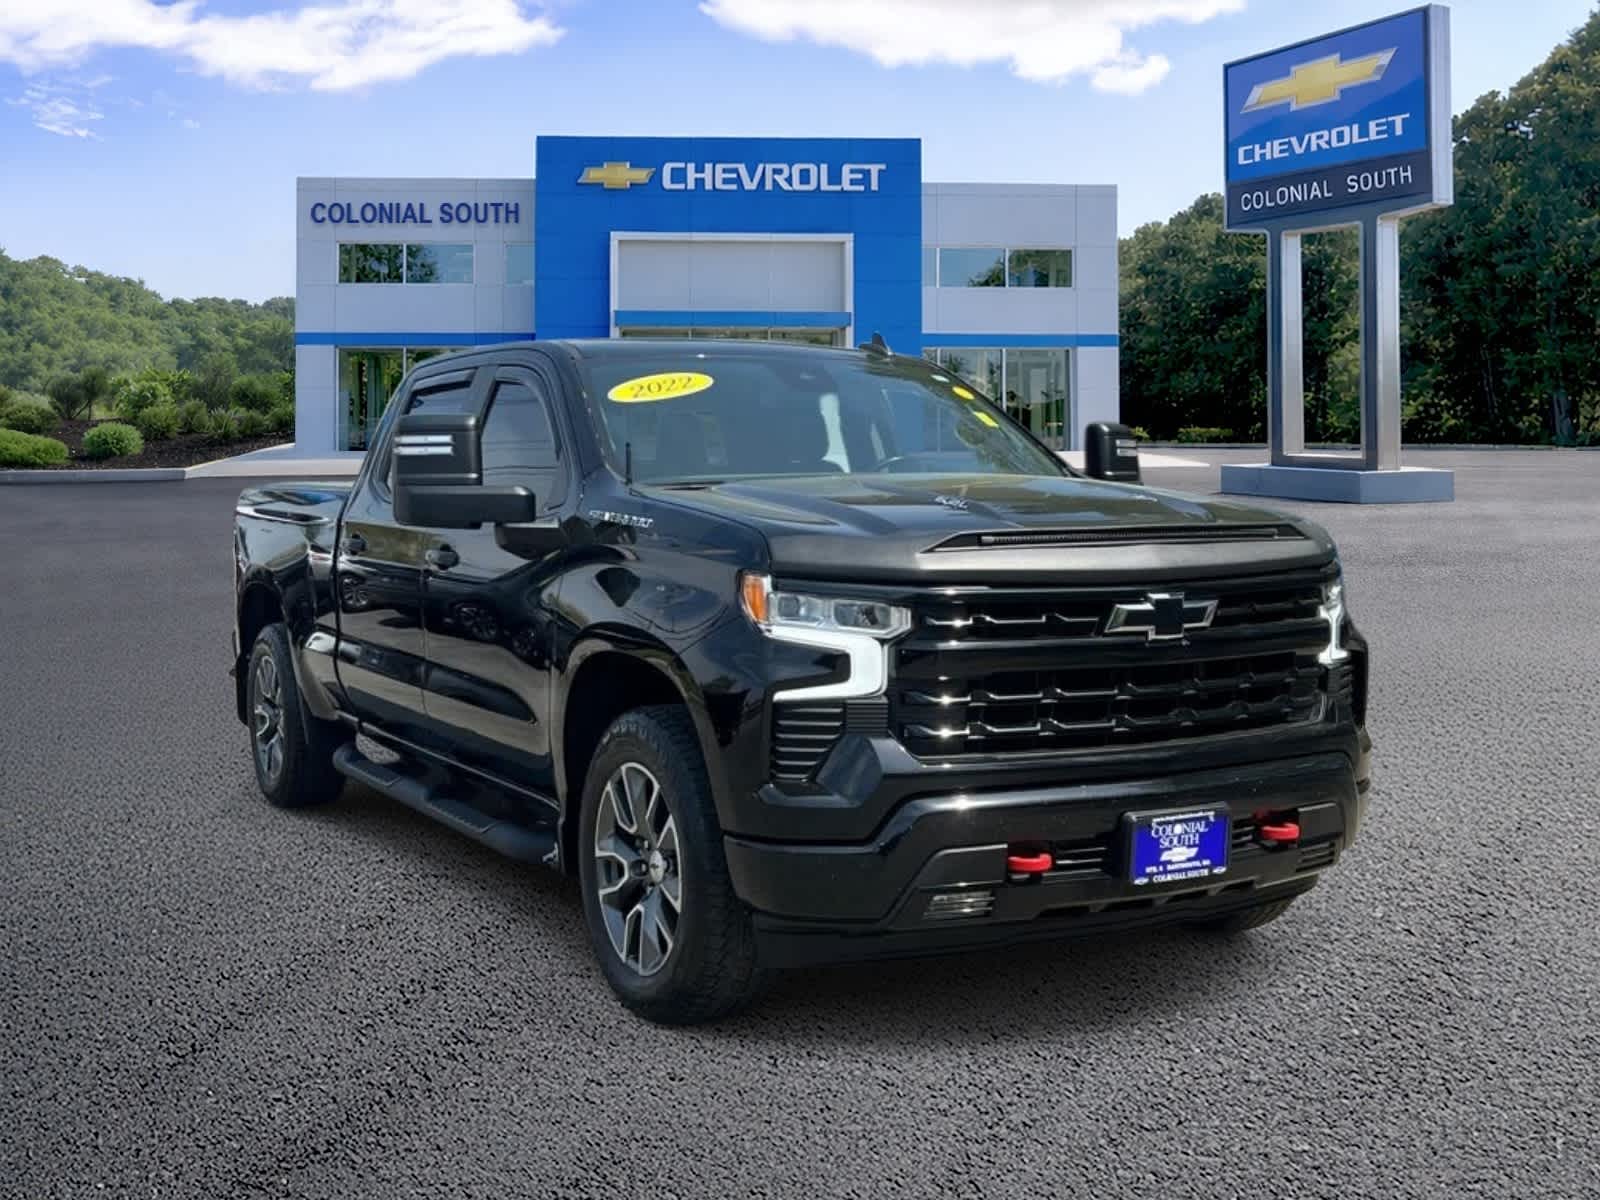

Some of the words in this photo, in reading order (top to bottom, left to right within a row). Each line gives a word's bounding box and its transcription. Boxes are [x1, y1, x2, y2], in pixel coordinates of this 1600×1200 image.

[1238, 113, 1410, 165] CHEVROLET
[662, 162, 887, 192] CHEVROLET
[1241, 180, 1333, 211] COLONIAL
[1346, 165, 1412, 193] SOUTH
[310, 202, 433, 224] COLONIAL
[439, 202, 520, 224] SOUTH
[629, 376, 693, 398] 2022
[1151, 820, 1209, 838] COLONIAL
[1160, 833, 1200, 848] SOUTH
